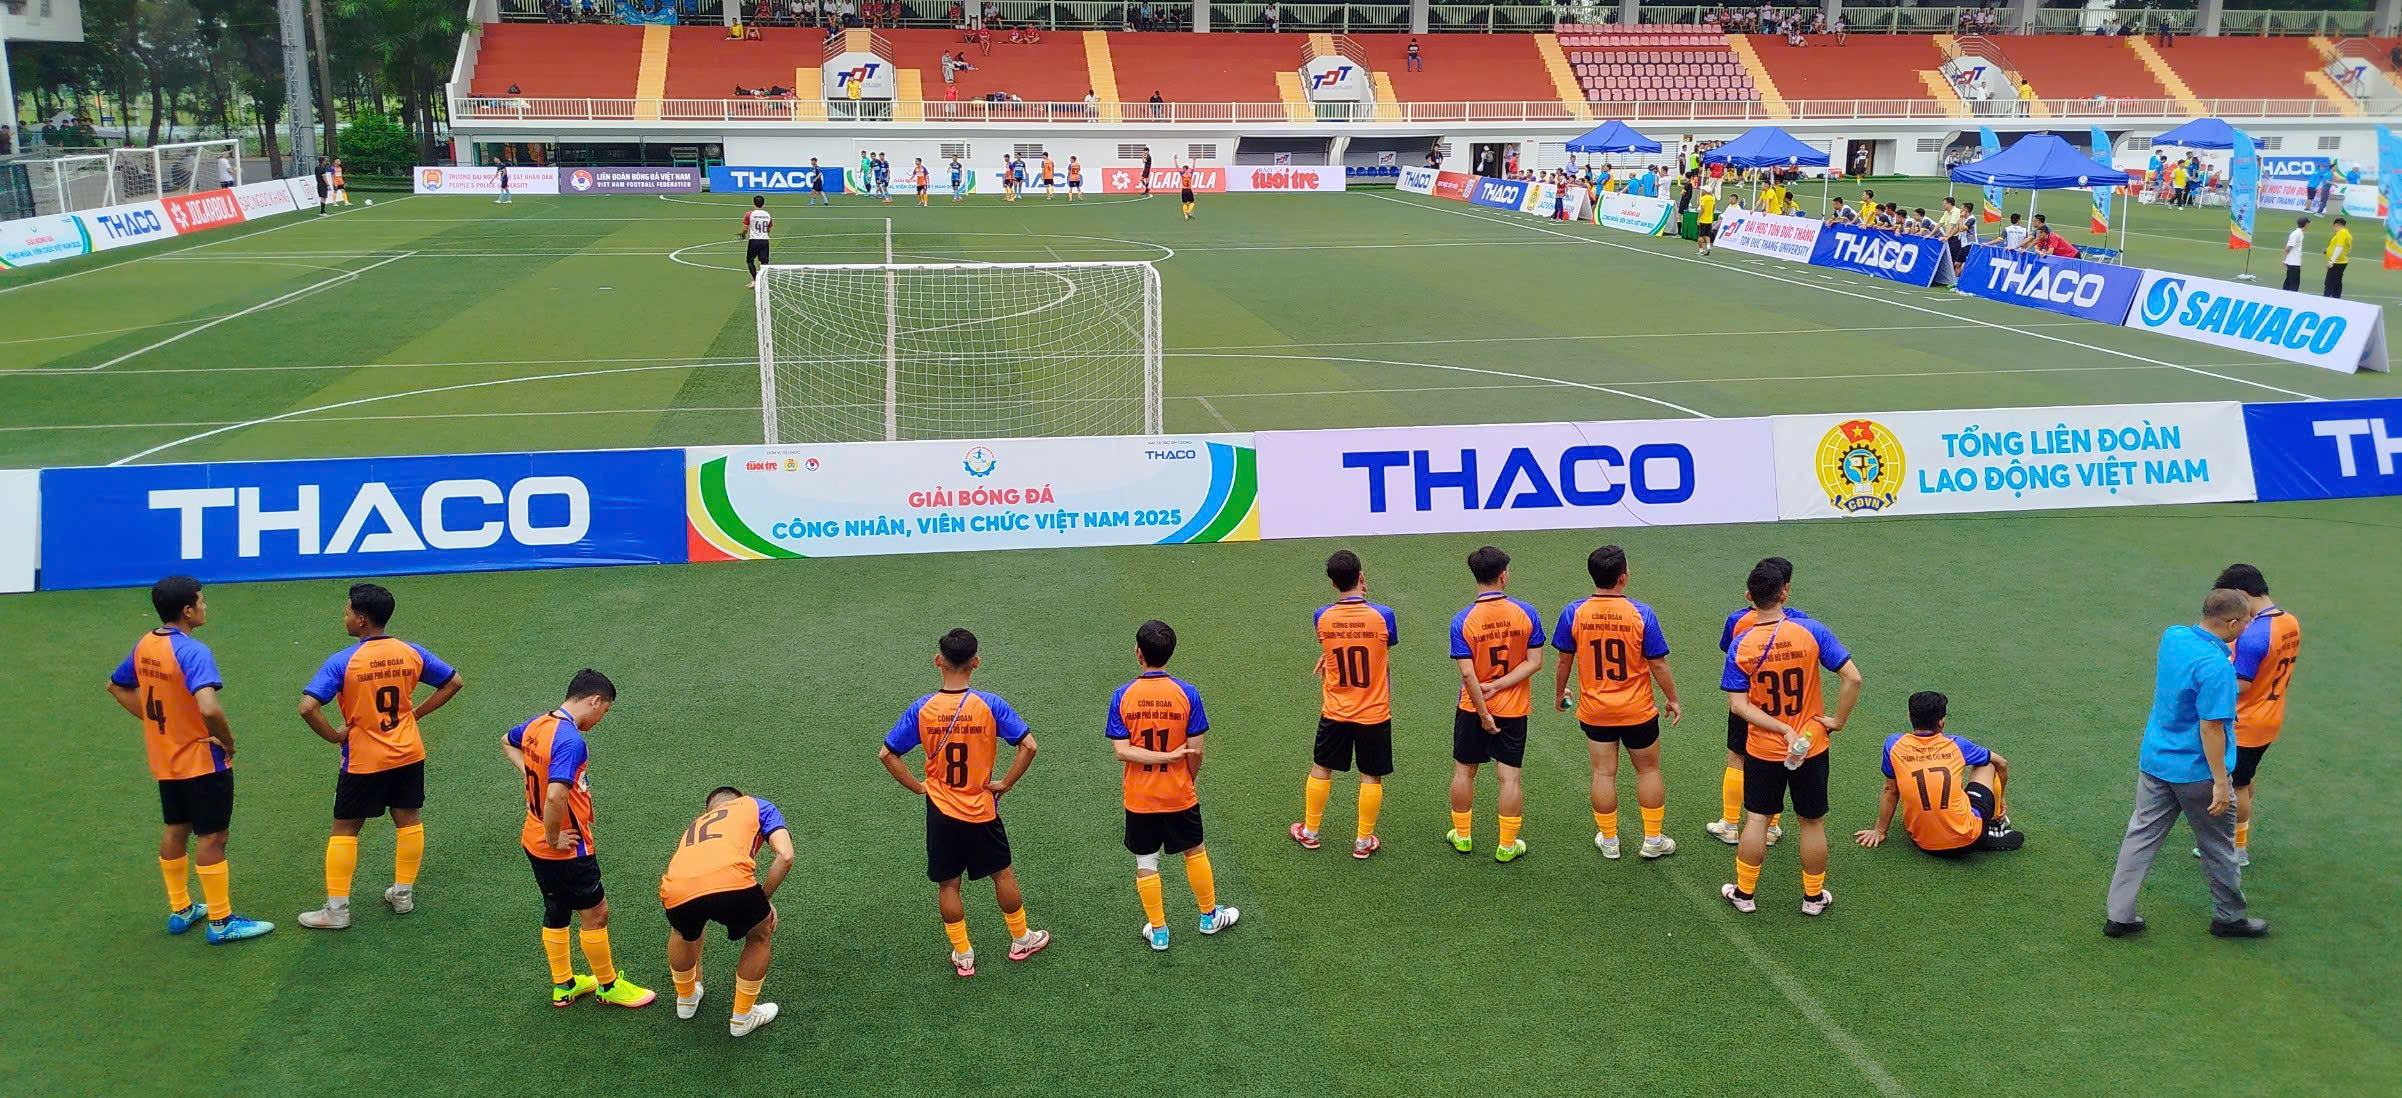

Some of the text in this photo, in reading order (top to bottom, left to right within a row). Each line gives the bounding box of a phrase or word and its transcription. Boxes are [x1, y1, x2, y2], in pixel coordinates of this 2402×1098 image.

[1405, 171, 1432, 189] THACO
[1480, 183, 1519, 204] THACO
[97, 209, 162, 239] THACO
[755, 220, 769, 233] 48
[1834, 232, 1919, 273] THACO
[1989, 257, 2105, 308] THACO
[2179, 290, 2347, 355] SAWACO
[1144, 450, 1196, 460] THACO
[1941, 418, 2181, 459] TỔNG LIÊN ĐOÀN
[908, 484, 1055, 508] GIẢI BÓNG ĐÁ
[1342, 443, 1695, 513] THACO
[1919, 459, 2209, 498] LAO ĐỘNG VIỆT NAM
[147, 476, 591, 560] THACO
[772, 508, 1181, 540] CÔNG NHÂN, VIÊN CHỨC VIỆT NAM 2025
[1333, 646, 1370, 688] 10
[1489, 644, 1509, 680] 5
[1590, 638, 1628, 681] 19
[146, 685, 166, 735] 4
[376, 686, 400, 732] 9
[1757, 667, 1804, 717] 39
[945, 742, 968, 788] 8
[1141, 727, 1169, 772] 11
[1911, 766, 1952, 811] 17
[685, 809, 728, 847] 12
